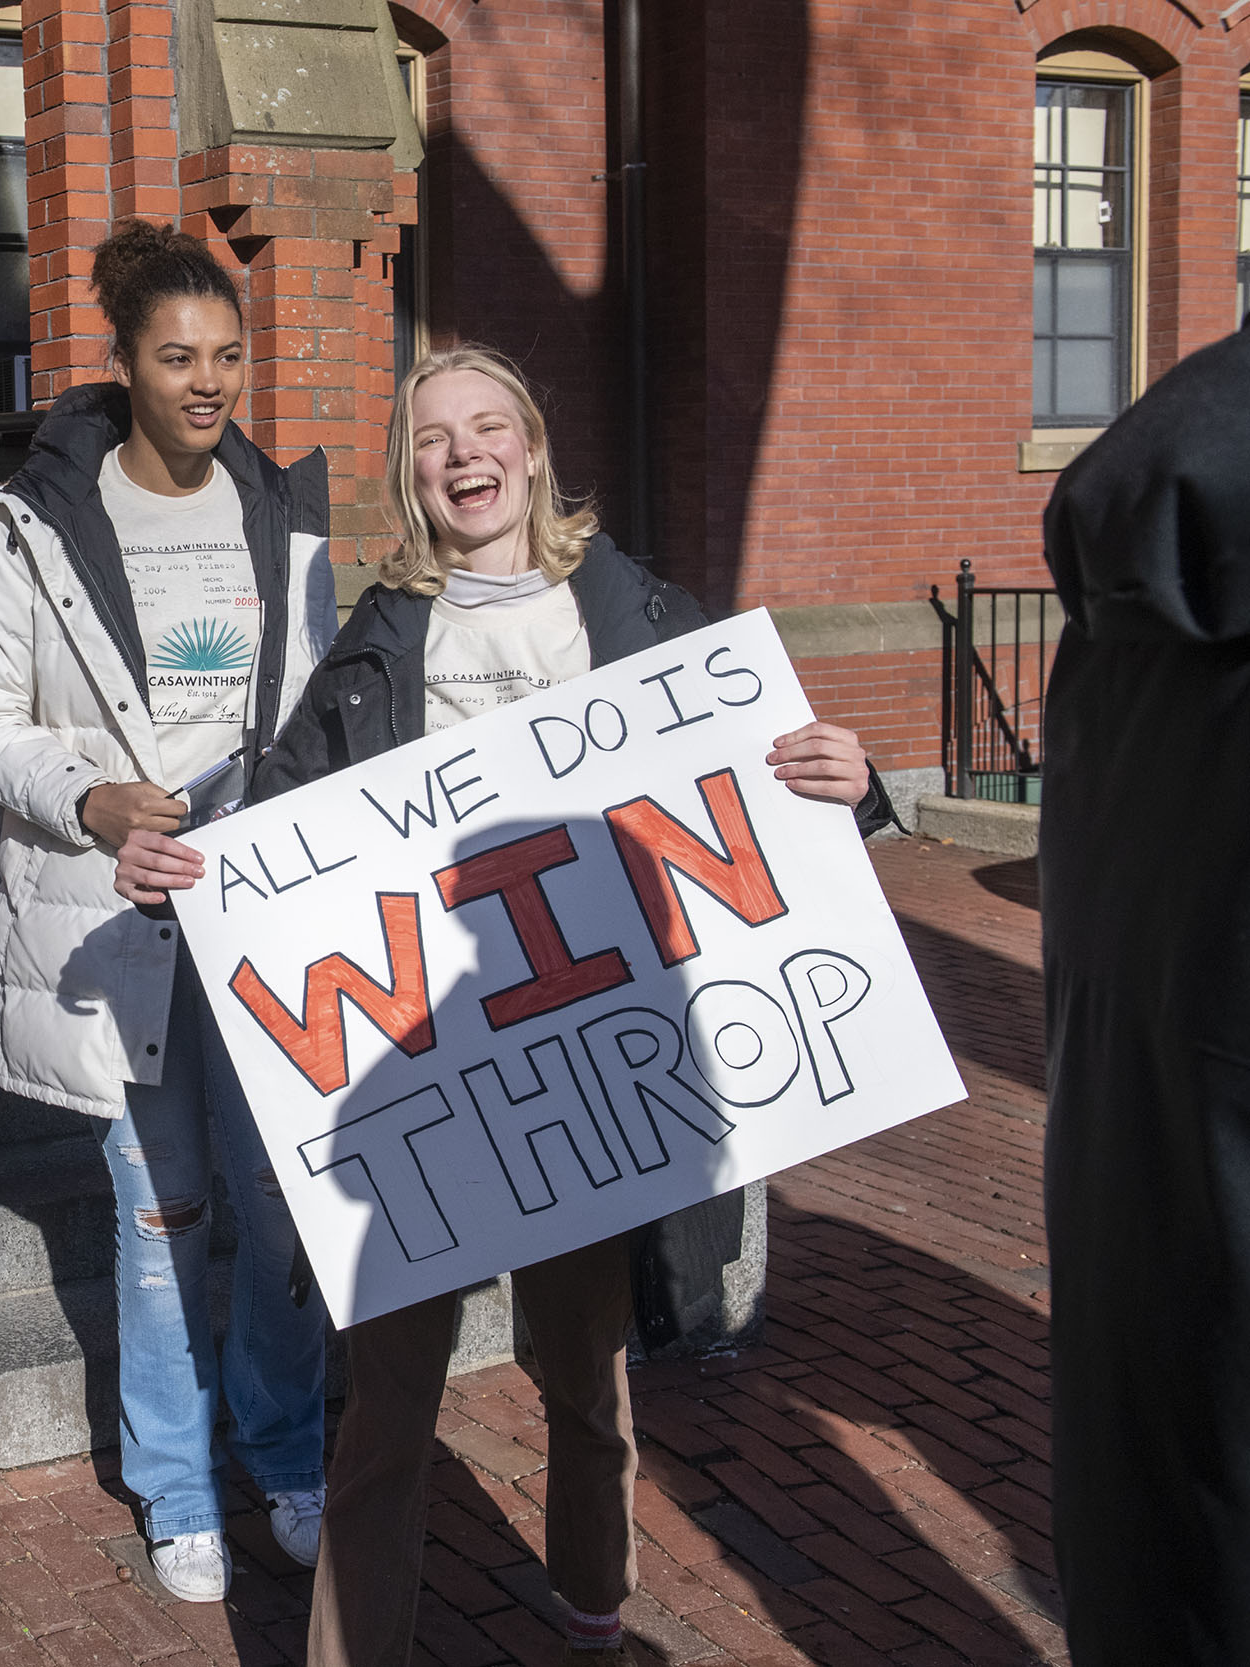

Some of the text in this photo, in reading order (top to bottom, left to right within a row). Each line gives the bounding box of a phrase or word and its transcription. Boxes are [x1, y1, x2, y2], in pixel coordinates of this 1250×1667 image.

[158, 542, 231, 552] CASAWINTHROP
[144, 565, 161, 573] Day
[149, 676, 251, 687] CASAWINTHROP
[187, 689, 200, 698] Est.
[222, 646, 763, 913] ALL WE DO IS
[228, 766, 789, 1097] WIN
[297, 948, 872, 1263] THROP
